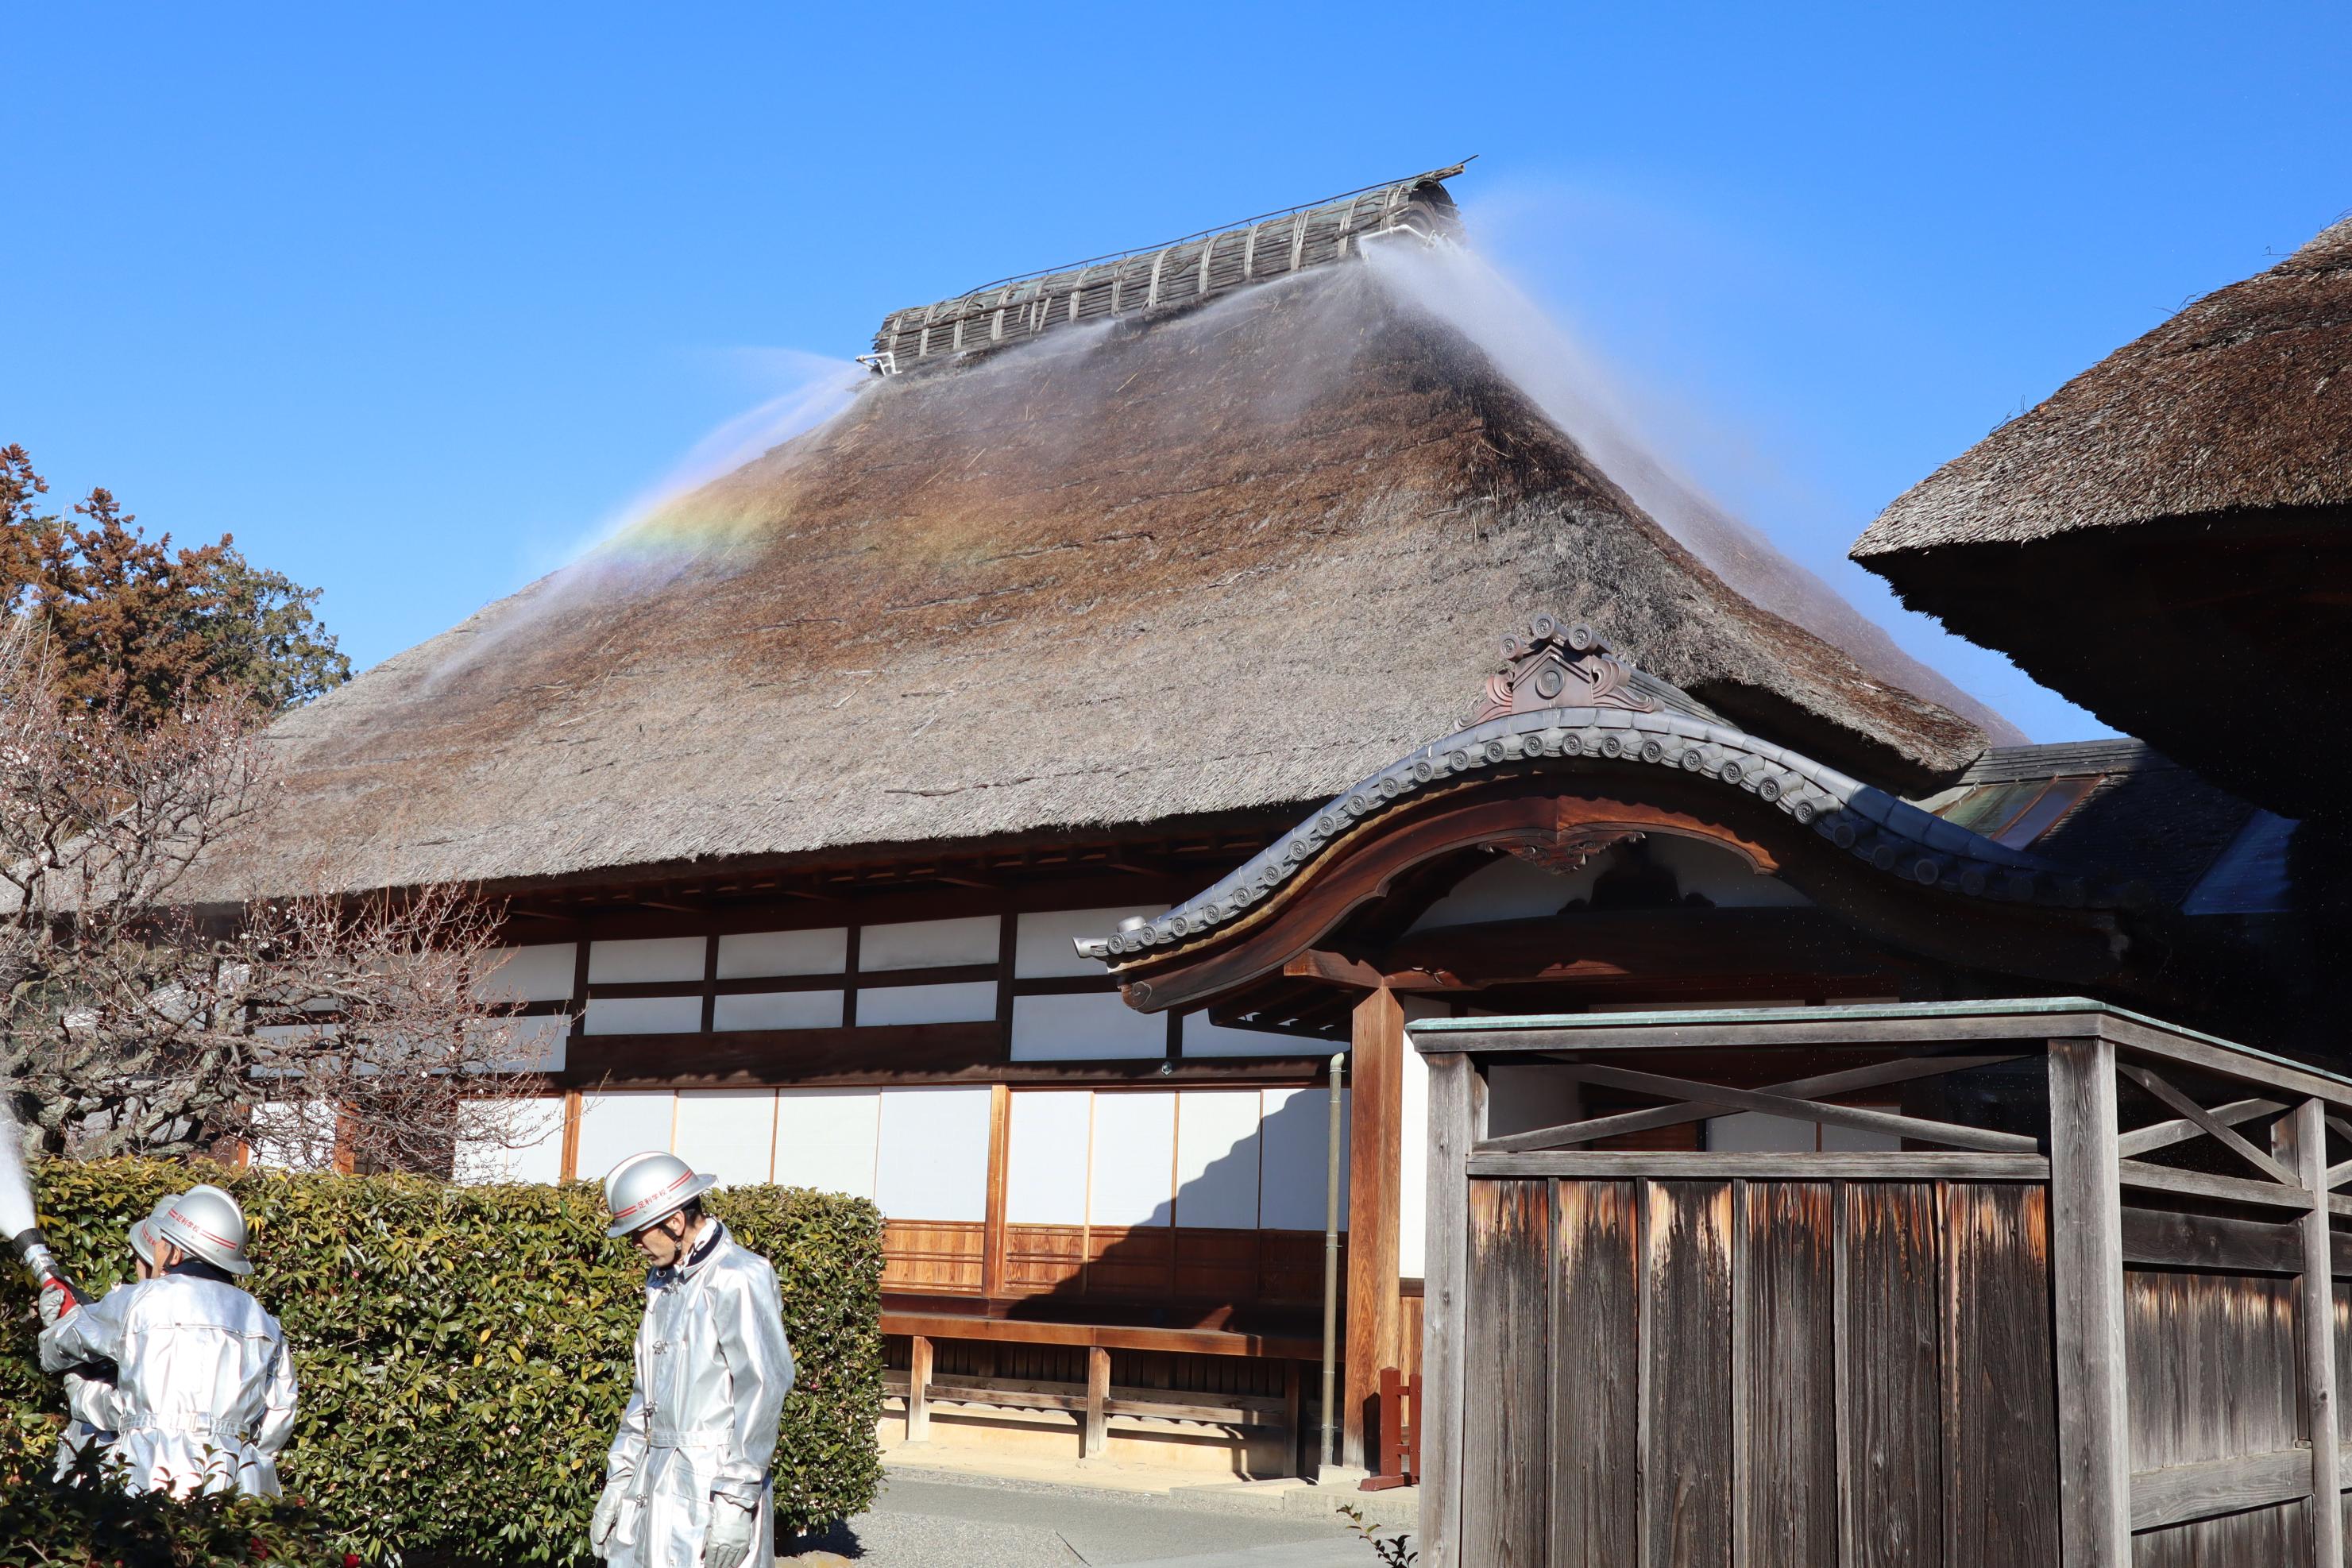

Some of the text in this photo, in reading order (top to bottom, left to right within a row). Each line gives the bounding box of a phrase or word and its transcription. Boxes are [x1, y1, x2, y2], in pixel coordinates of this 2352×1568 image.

[638, 1189, 666, 1209] 足利学校
[177, 1214, 200, 1232] 足利学校
